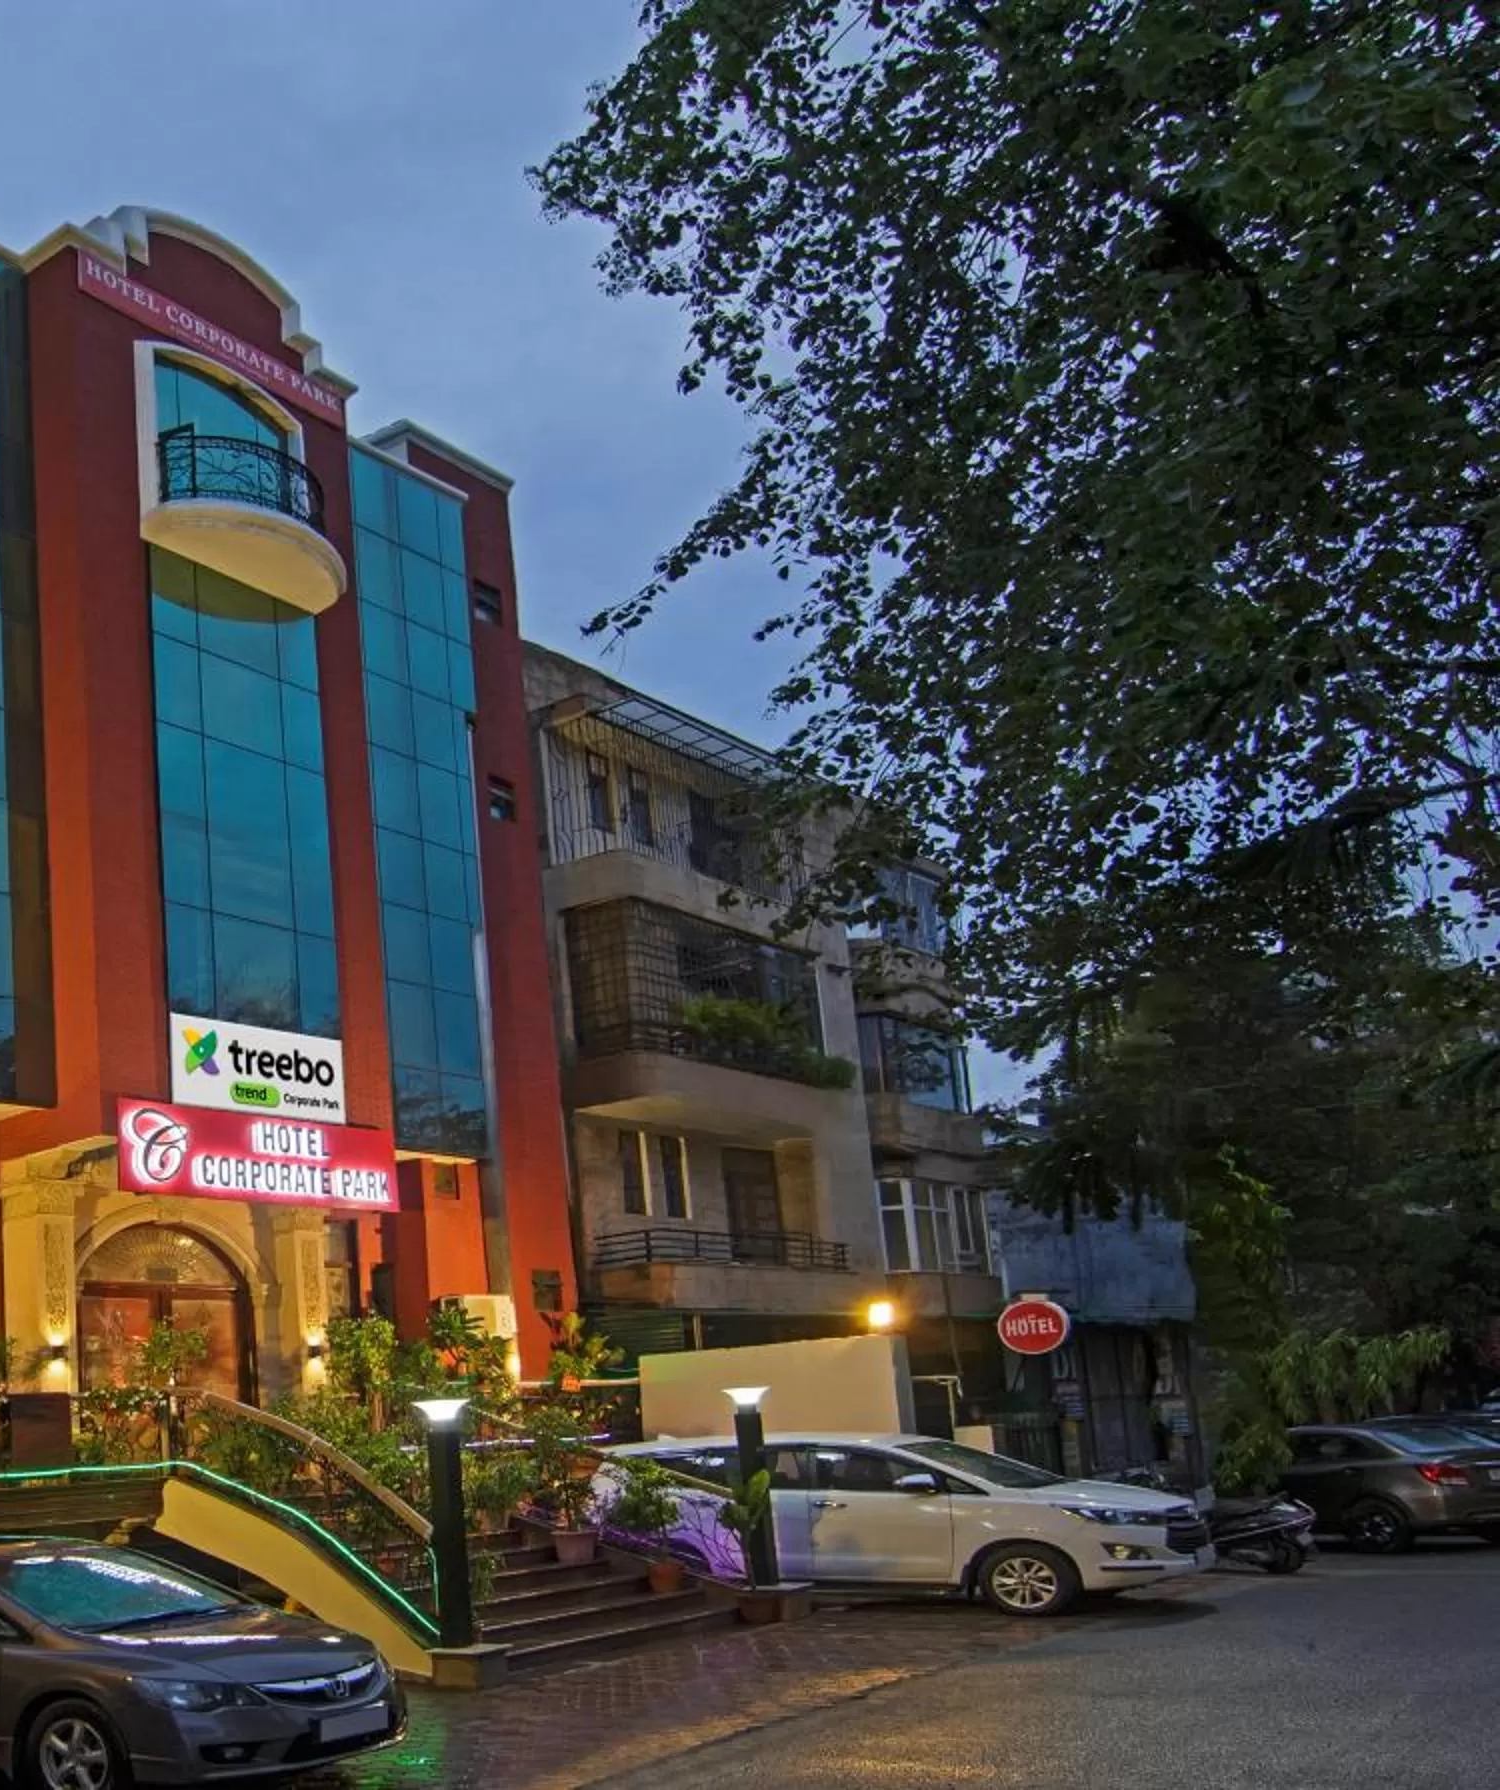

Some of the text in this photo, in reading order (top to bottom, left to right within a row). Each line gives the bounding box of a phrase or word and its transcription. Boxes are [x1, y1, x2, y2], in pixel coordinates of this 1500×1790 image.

[84, 258, 161, 315] HOTEL
[164, 303, 286, 383] CORPORATE
[290, 373, 340, 412] PARK
[228, 1039, 336, 1088] treebo
[235, 1083, 268, 1102] trend
[283, 1092, 341, 1110] Corporate Park
[252, 1120, 332, 1160] HOTEL
[192, 1153, 392, 1203] CORPORATE PARK
[1005, 1316, 1060, 1338] HOTEL
